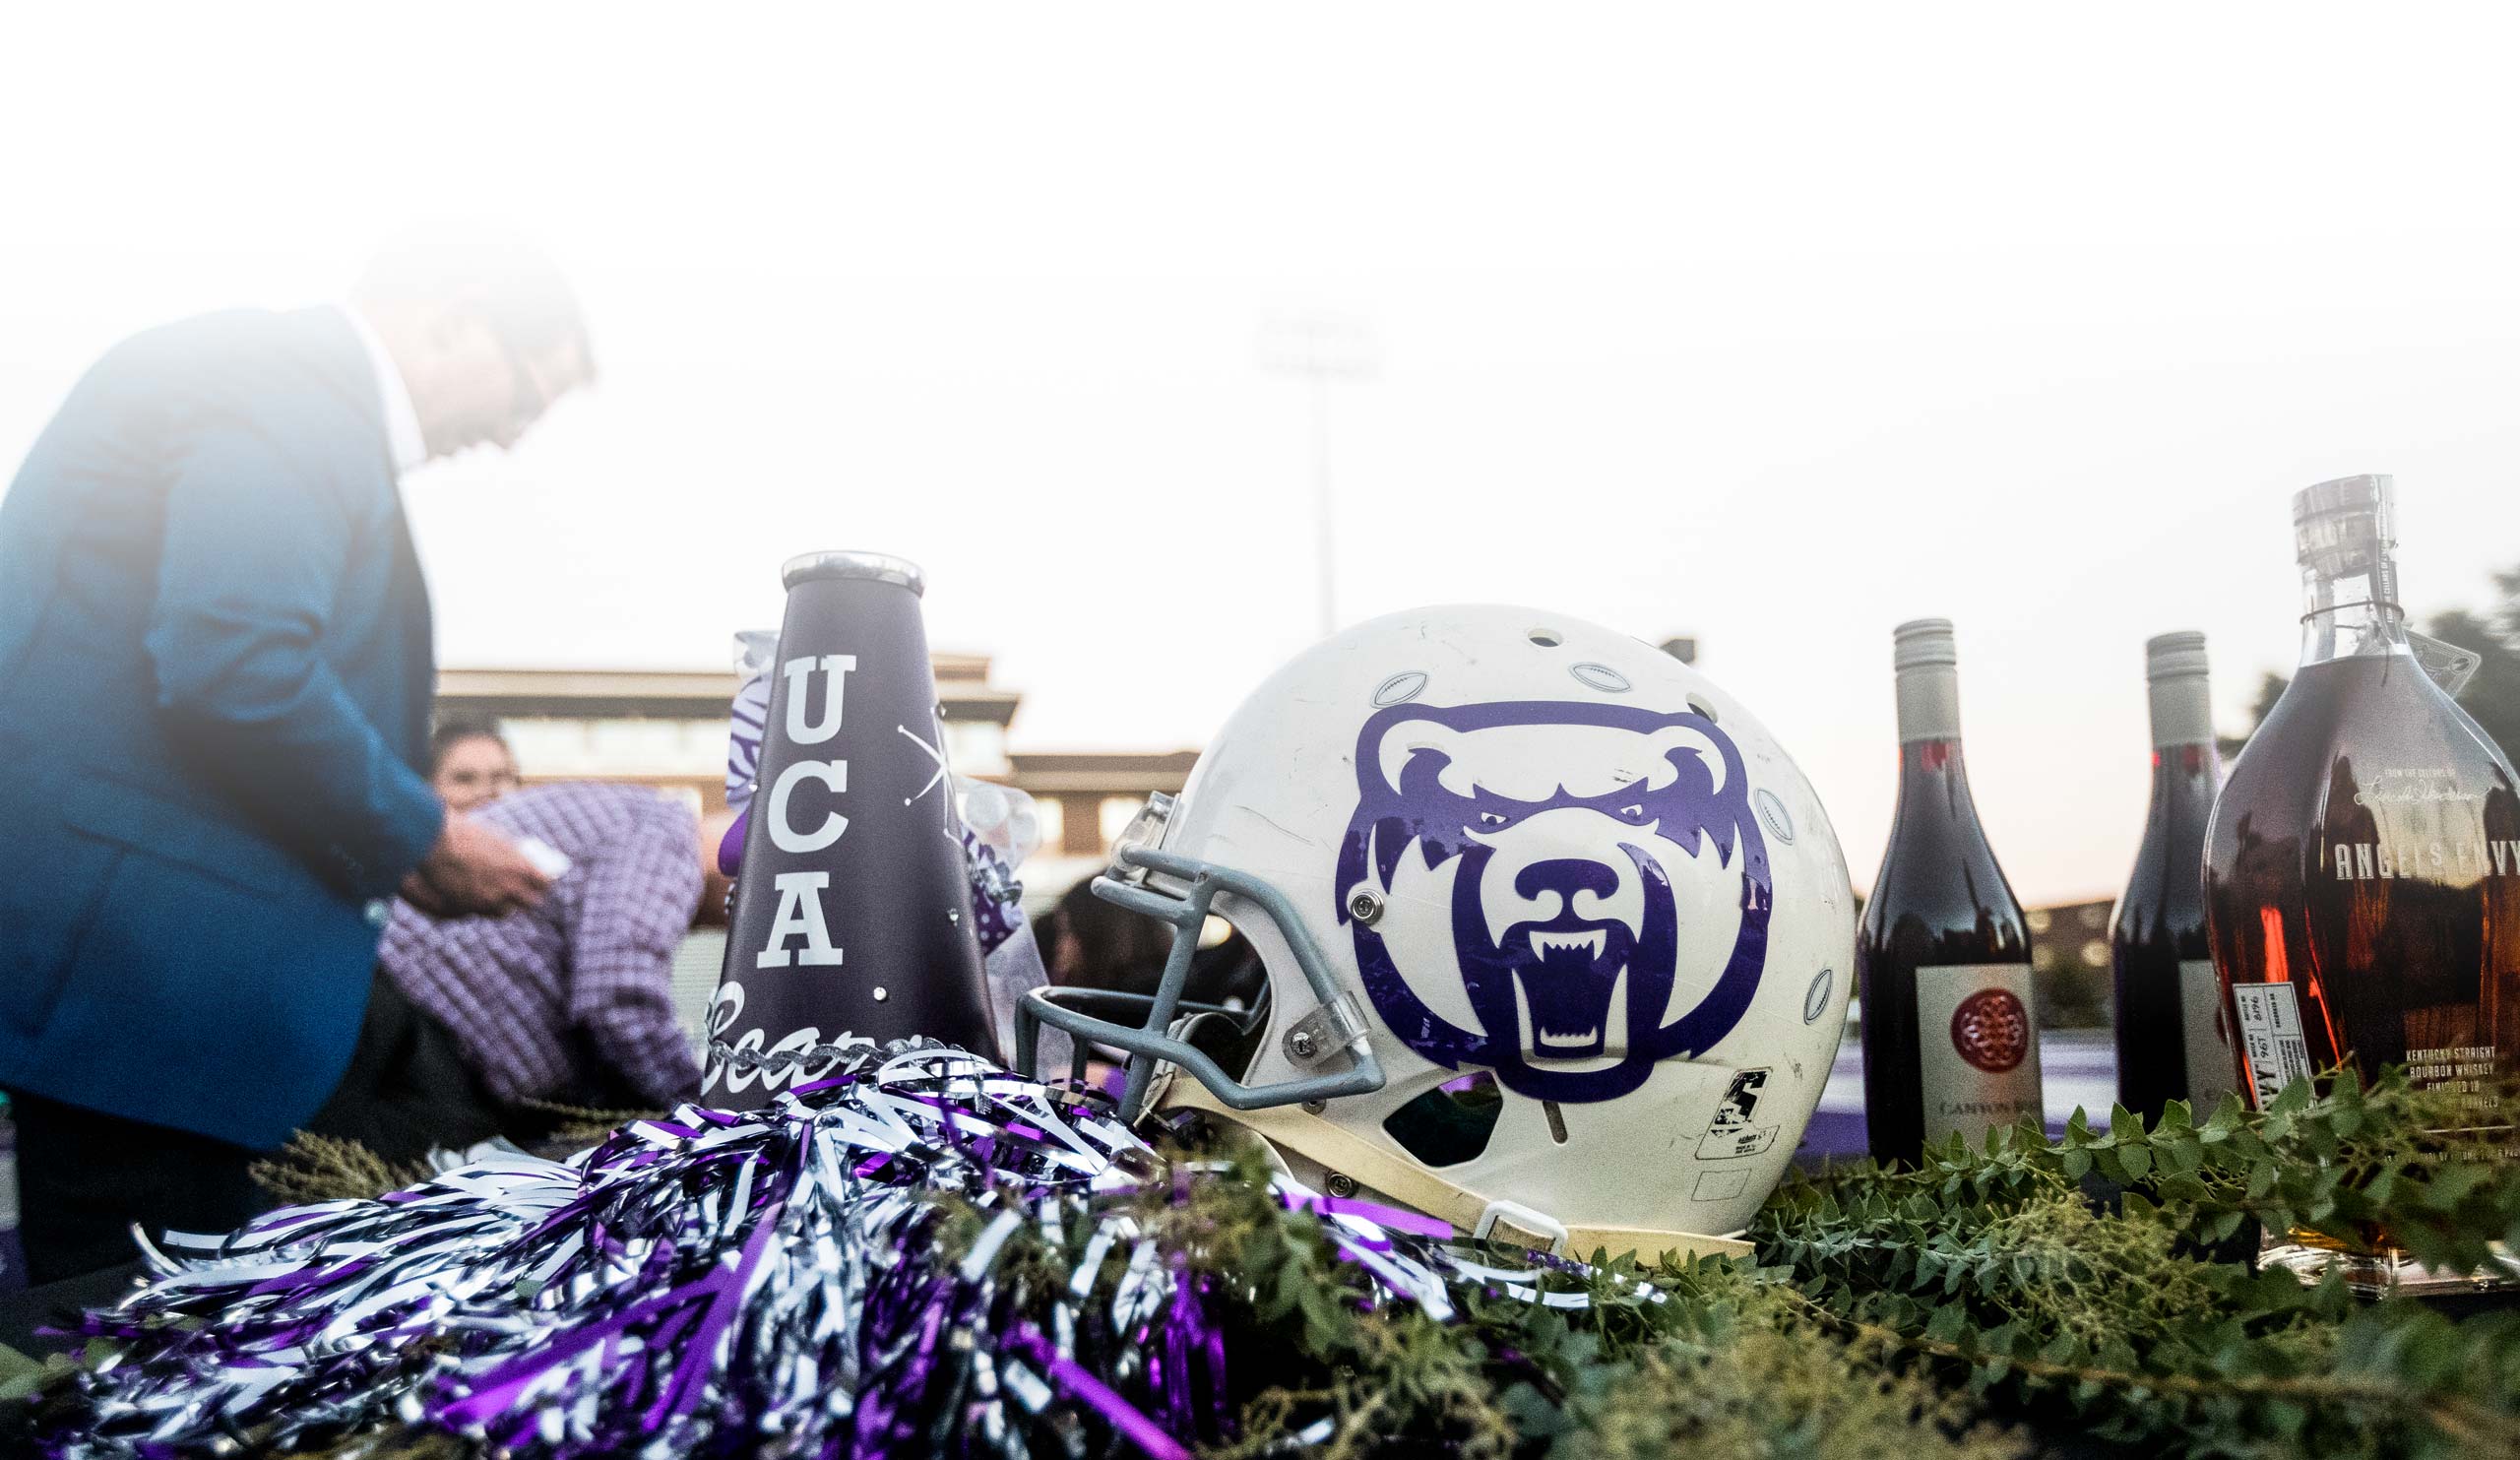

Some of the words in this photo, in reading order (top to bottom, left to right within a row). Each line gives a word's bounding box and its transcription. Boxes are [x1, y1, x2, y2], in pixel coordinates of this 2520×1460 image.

[756, 654, 857, 969] UCA
[2406, 1049, 2451, 1061] KENTUCKY
[2454, 1047, 2494, 1058] STRAIGHT
[2410, 1066, 2452, 1077] BOURBON
[2455, 1064, 2493, 1075] WHISKEY
